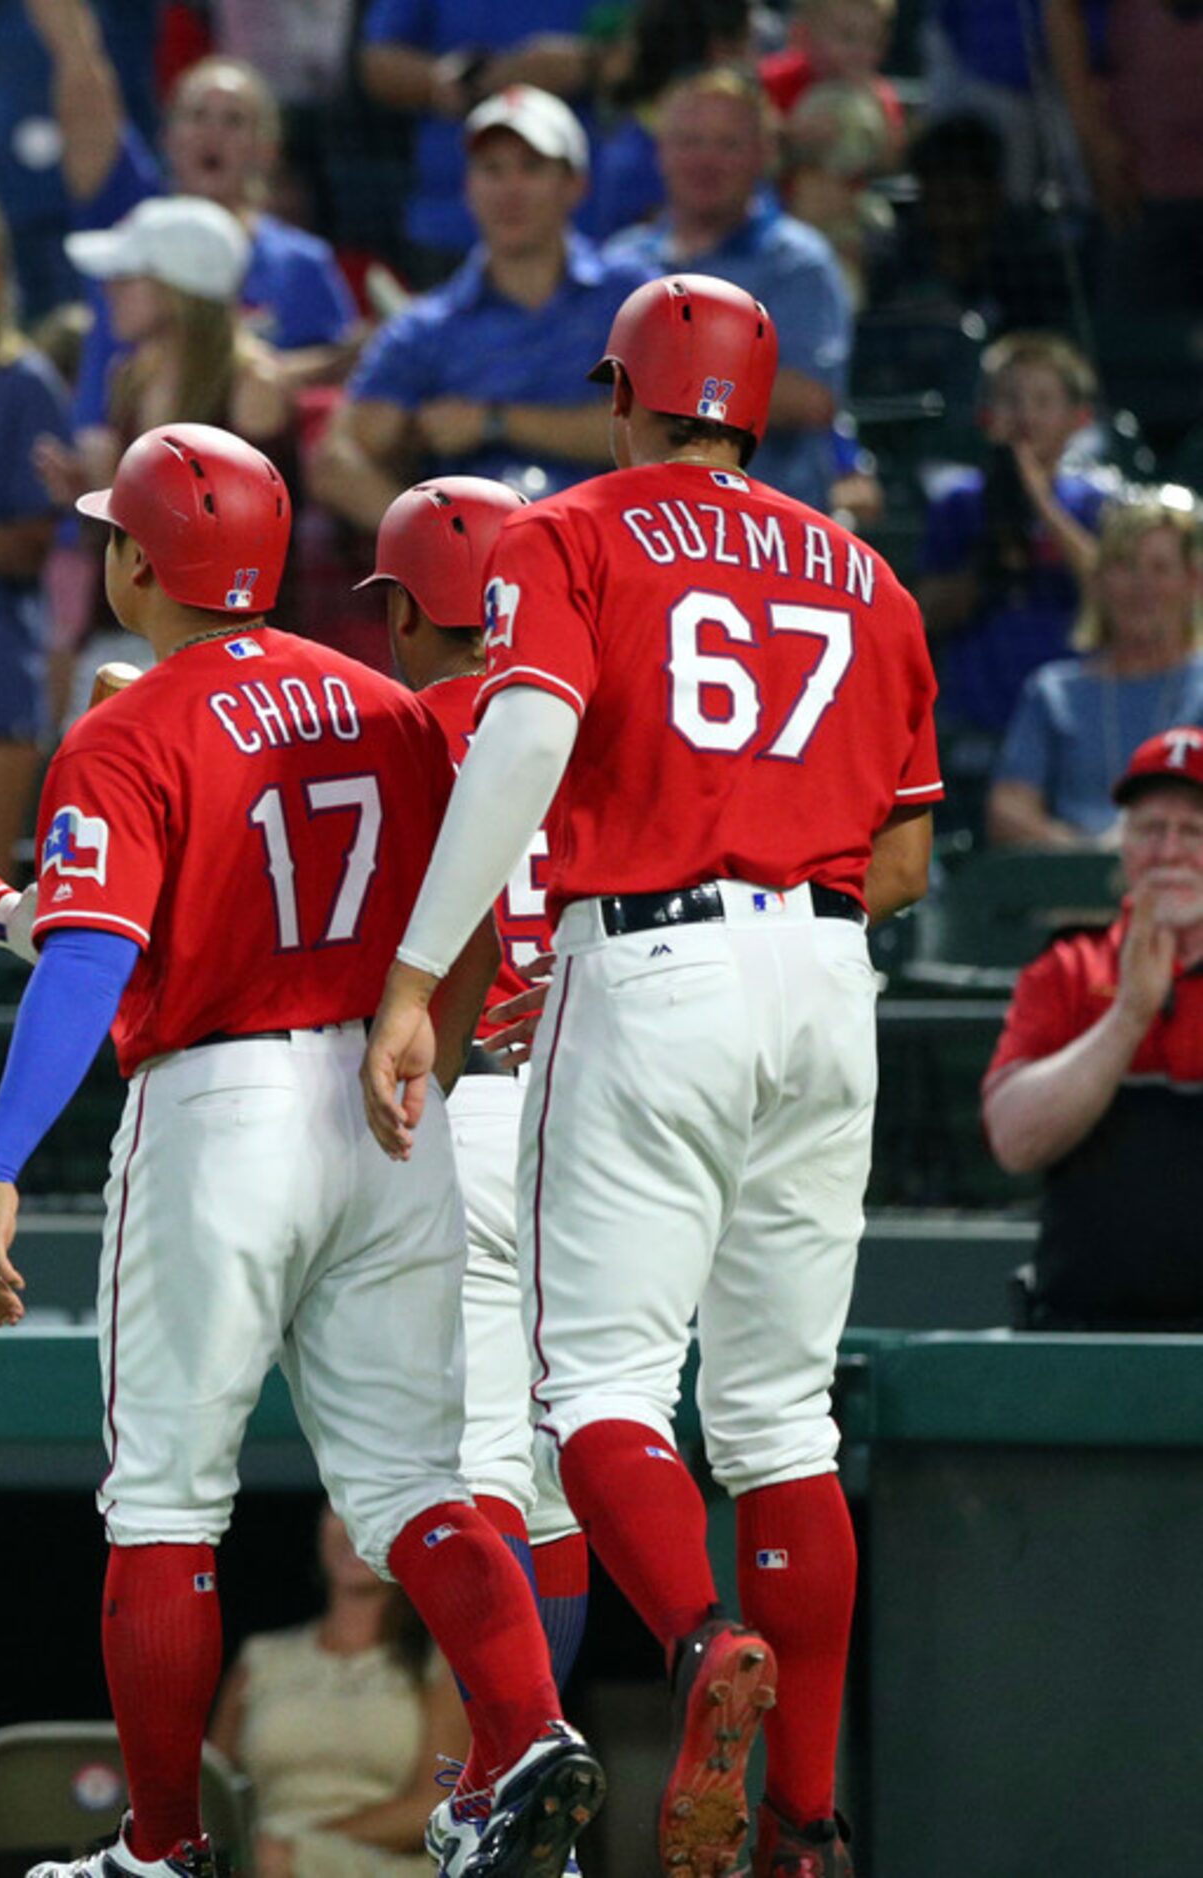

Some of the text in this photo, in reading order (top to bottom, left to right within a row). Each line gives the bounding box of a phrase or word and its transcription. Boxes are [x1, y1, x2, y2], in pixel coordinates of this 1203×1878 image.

[702, 376, 735, 402] 67
[234, 568, 259, 591] 17
[622, 499, 875, 606] GUZMAN
[208, 676, 360, 754] CHOO
[663, 586, 854, 771] 67
[247, 771, 384, 955] 17
